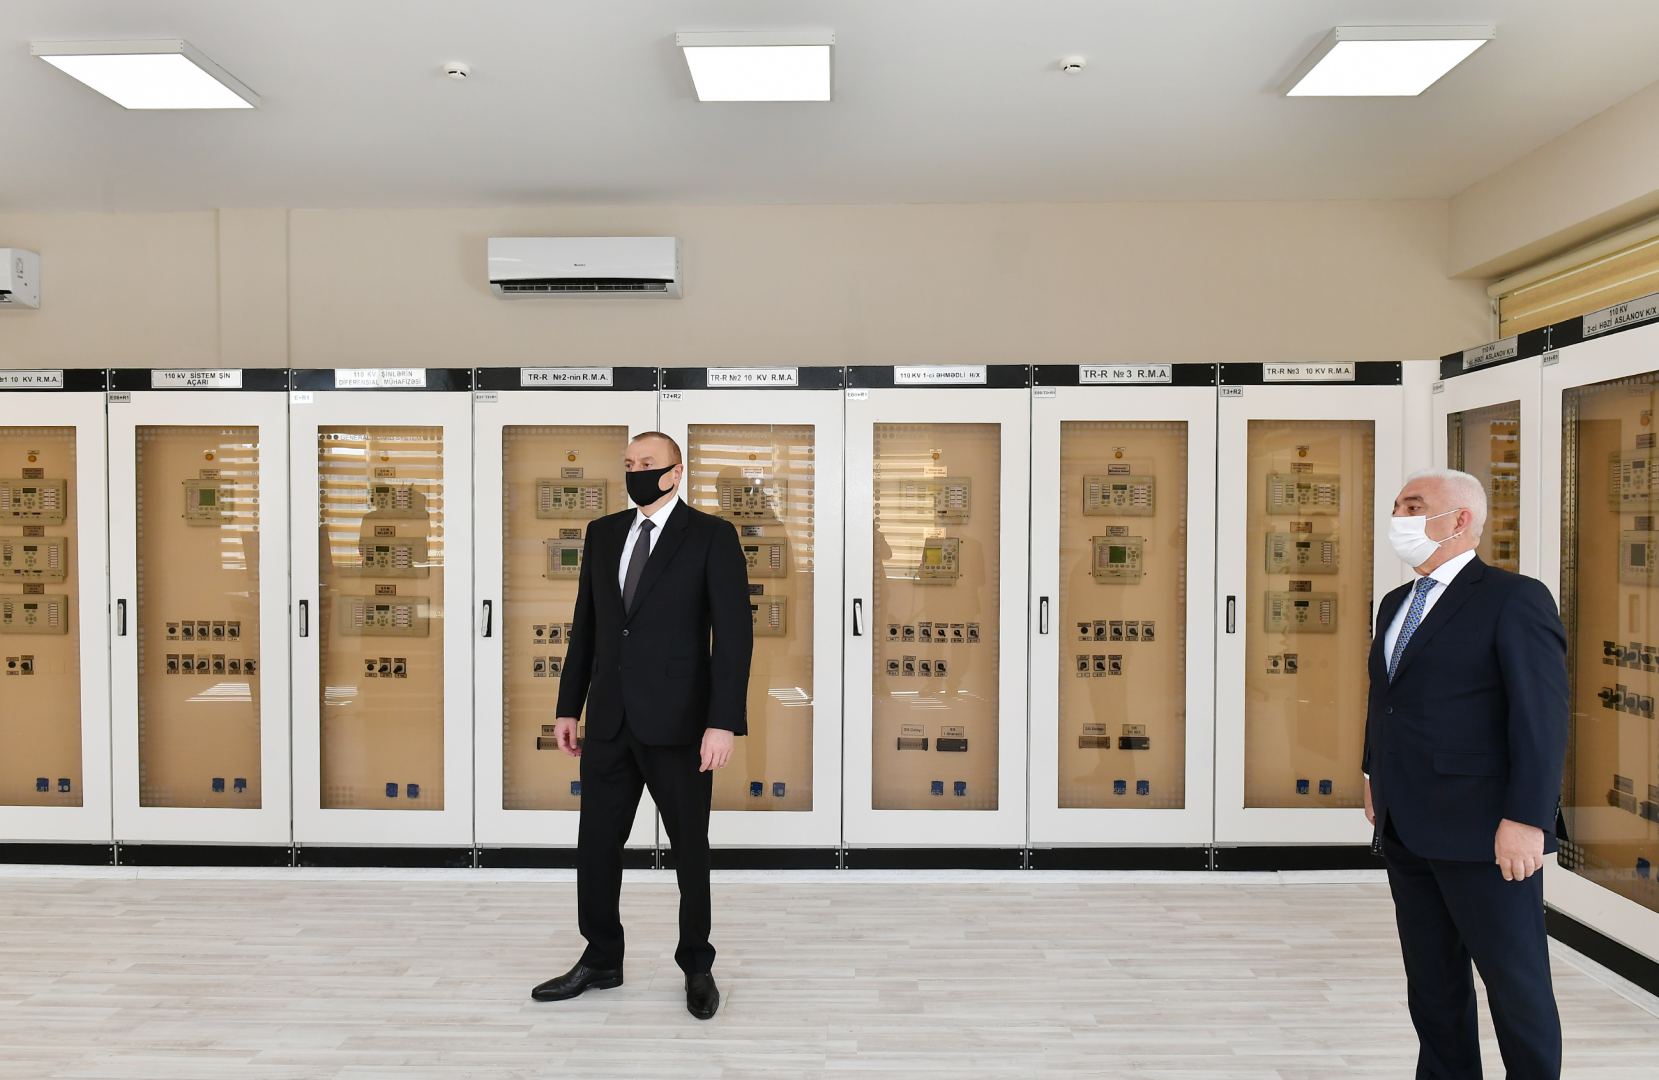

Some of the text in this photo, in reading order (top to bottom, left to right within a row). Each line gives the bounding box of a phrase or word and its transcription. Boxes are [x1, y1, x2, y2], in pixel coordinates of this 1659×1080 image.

[1609, 304, 1628, 316] 110 KV
[1614, 310, 1645, 324] ASLANOV
[1645, 306, 1657, 316] K/X
[1485, 350, 1506, 361] ASLANOV
[771, 373, 794, 381] R.M.A.
[1084, 370, 1108, 378] TR-R
[1137, 370, 1169, 378] R.M.A.
